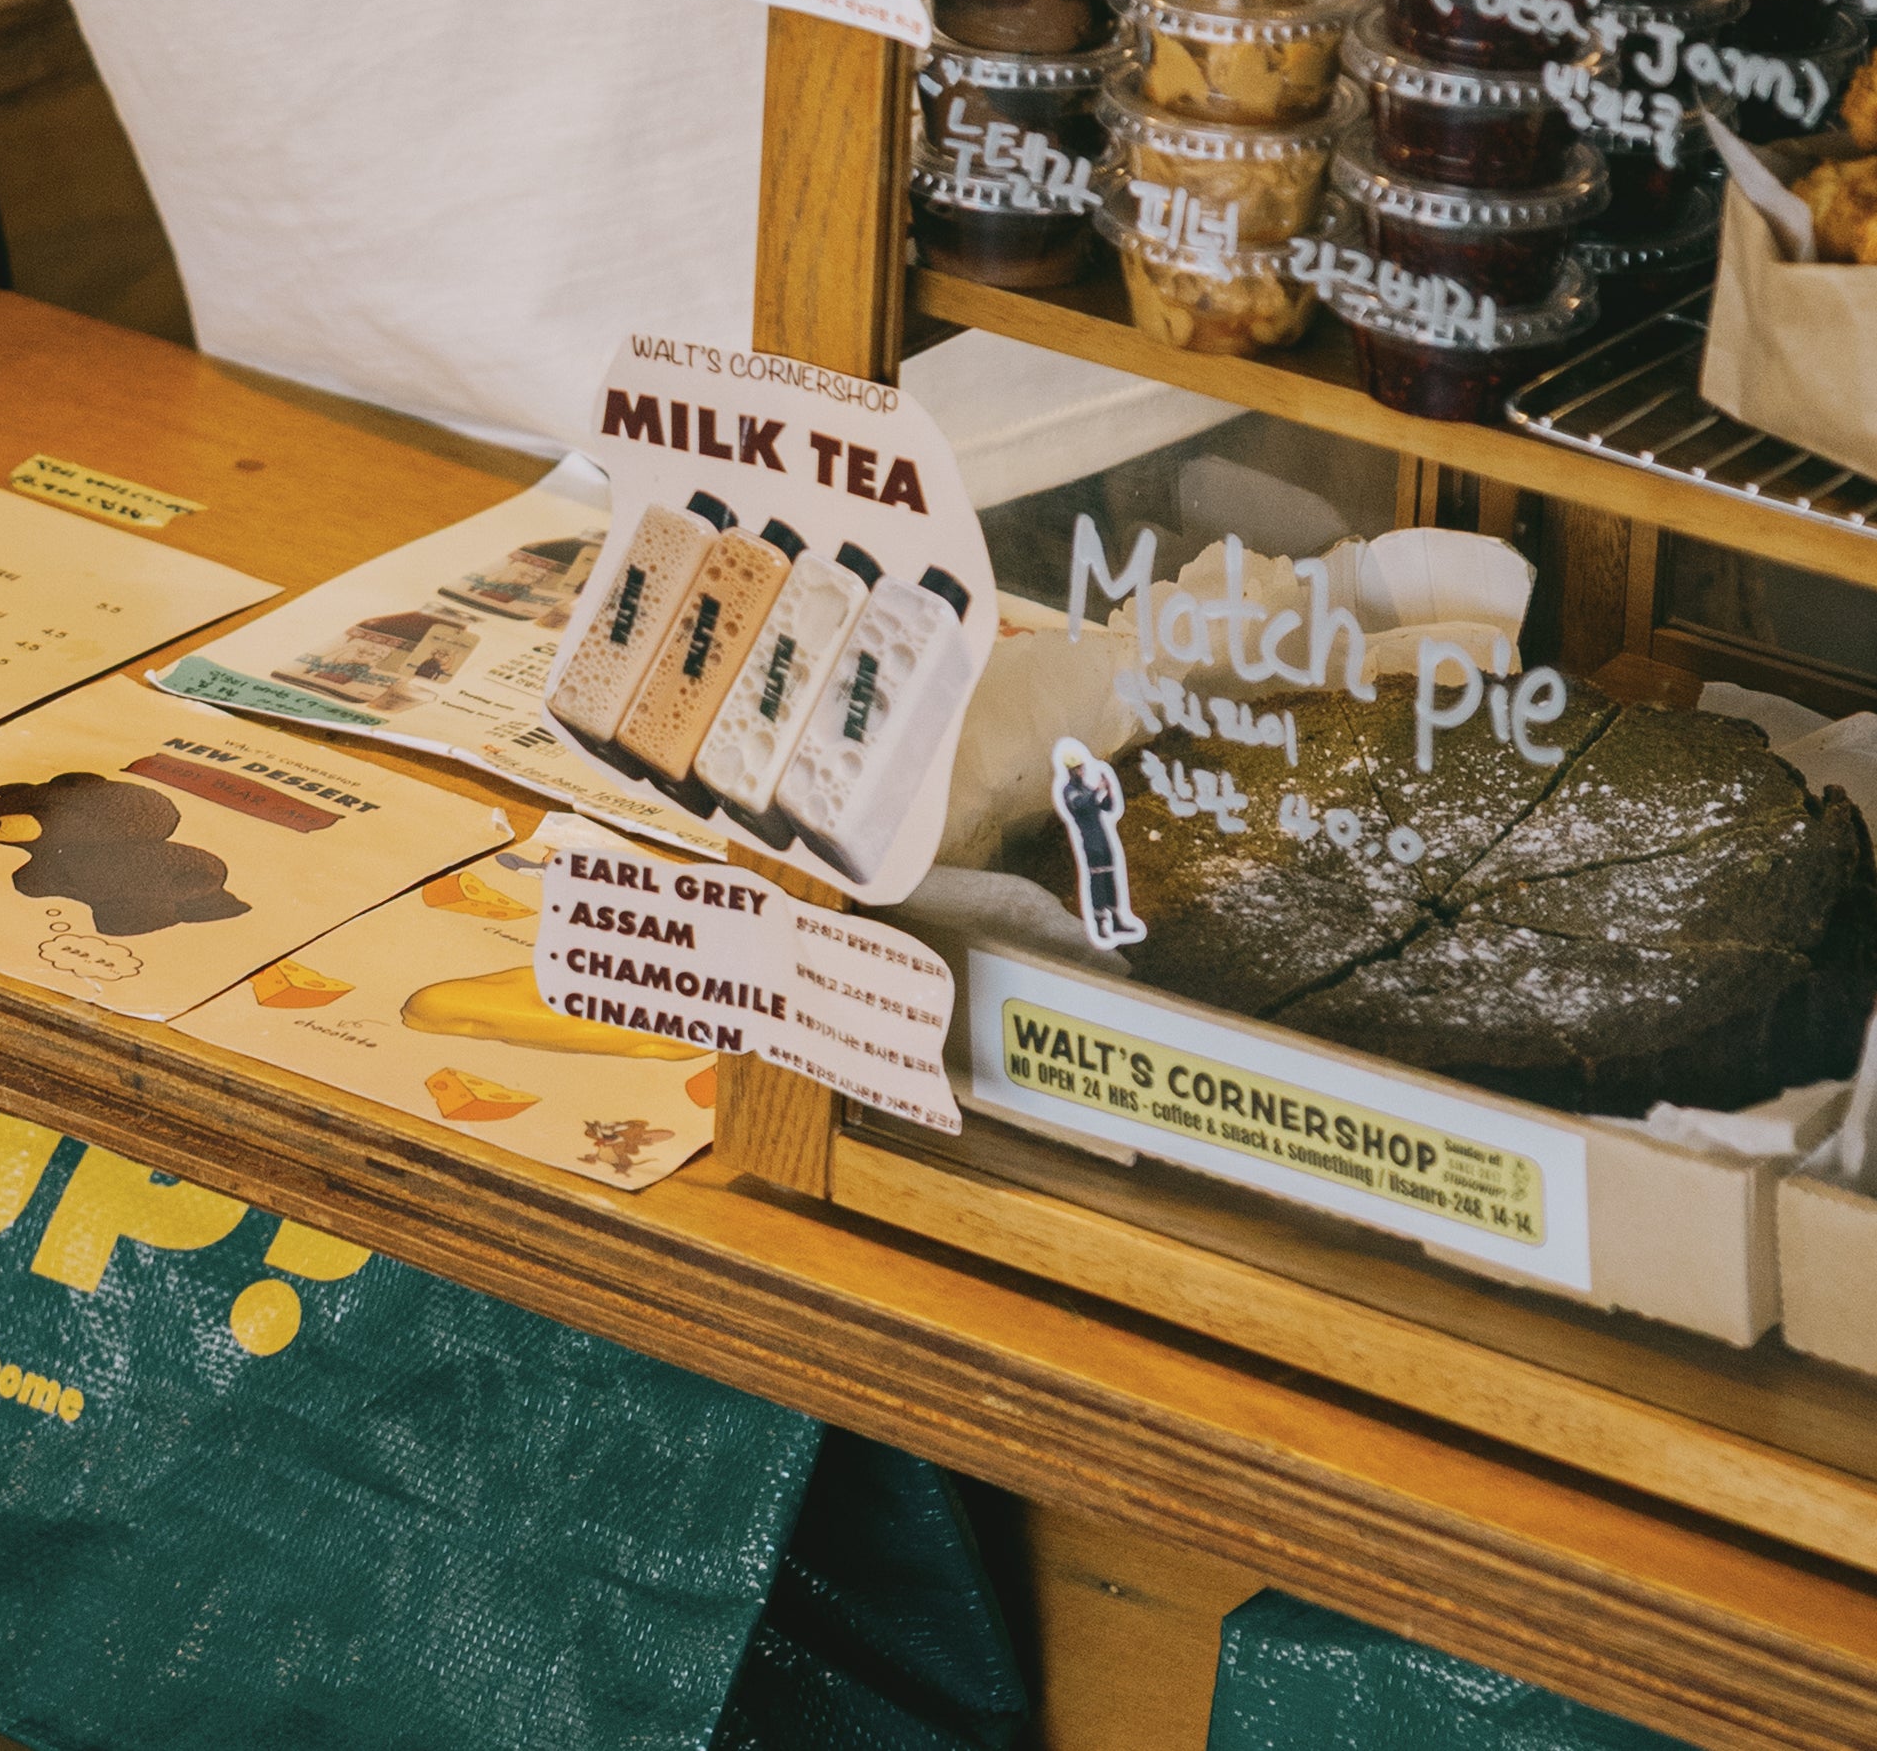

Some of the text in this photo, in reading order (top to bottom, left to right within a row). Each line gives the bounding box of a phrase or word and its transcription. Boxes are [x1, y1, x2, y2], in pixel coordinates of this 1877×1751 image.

[630, 333, 900, 415] WALT'S CORNERSHOP
[601, 387, 931, 517] MILK TEA
[1067, 511, 1378, 703] Match
[163, 737, 382, 813] NEW DESSERT
[1279, 793, 1425, 865] 40.0
[570, 852, 770, 918] EARL GREY
[569, 900, 697, 950] ASSAM
[795, 914, 948, 983] 향긋하고 달달한 맛의 밀크티
[565, 948, 789, 1022] CHAMOMILE
[841, 981, 877, 1007] 고소한
[879, 996, 903, 1016] 맛의
[905, 1005, 944, 1031] 밀크티
[292, 1017, 379, 1050] chocolate
[564, 992, 744, 1053] CINAMON
[863, 1040, 900, 1063] 화사한
[902, 1053, 941, 1078] 밀크티
[1012, 1013, 1437, 1173] WALT'S CORNERSHOP
[1010, 1053, 1375, 1189] NO OPEN 24 HRS coffee & snack & something
